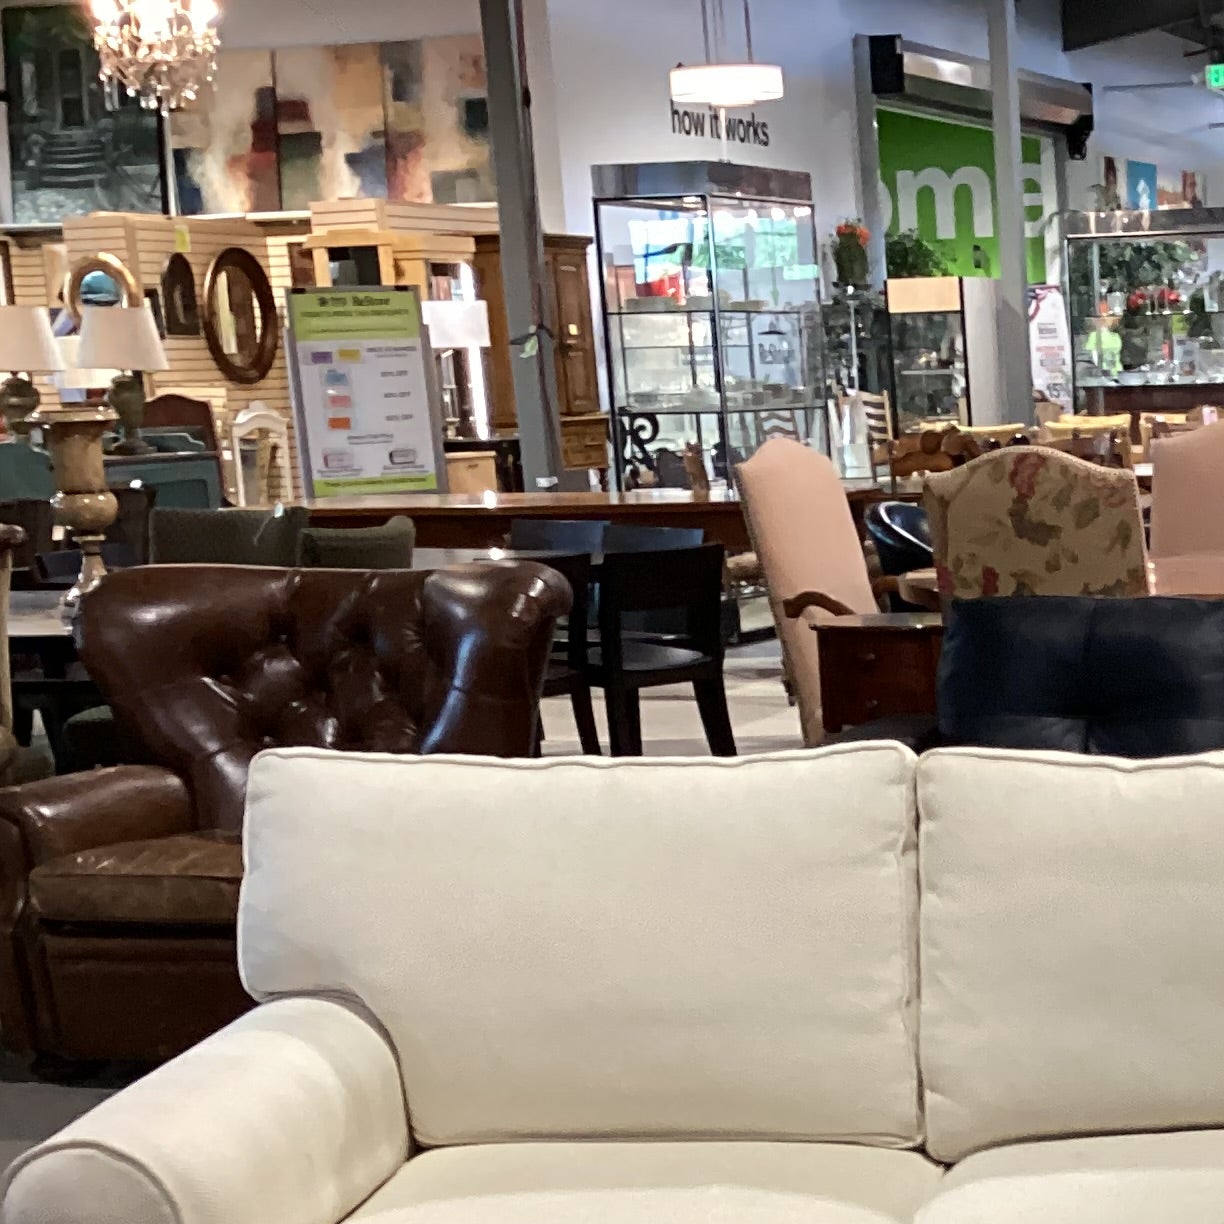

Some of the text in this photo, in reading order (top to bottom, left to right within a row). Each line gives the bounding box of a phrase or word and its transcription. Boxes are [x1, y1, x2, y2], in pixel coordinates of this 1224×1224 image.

[670, 98, 770, 147] how it works
